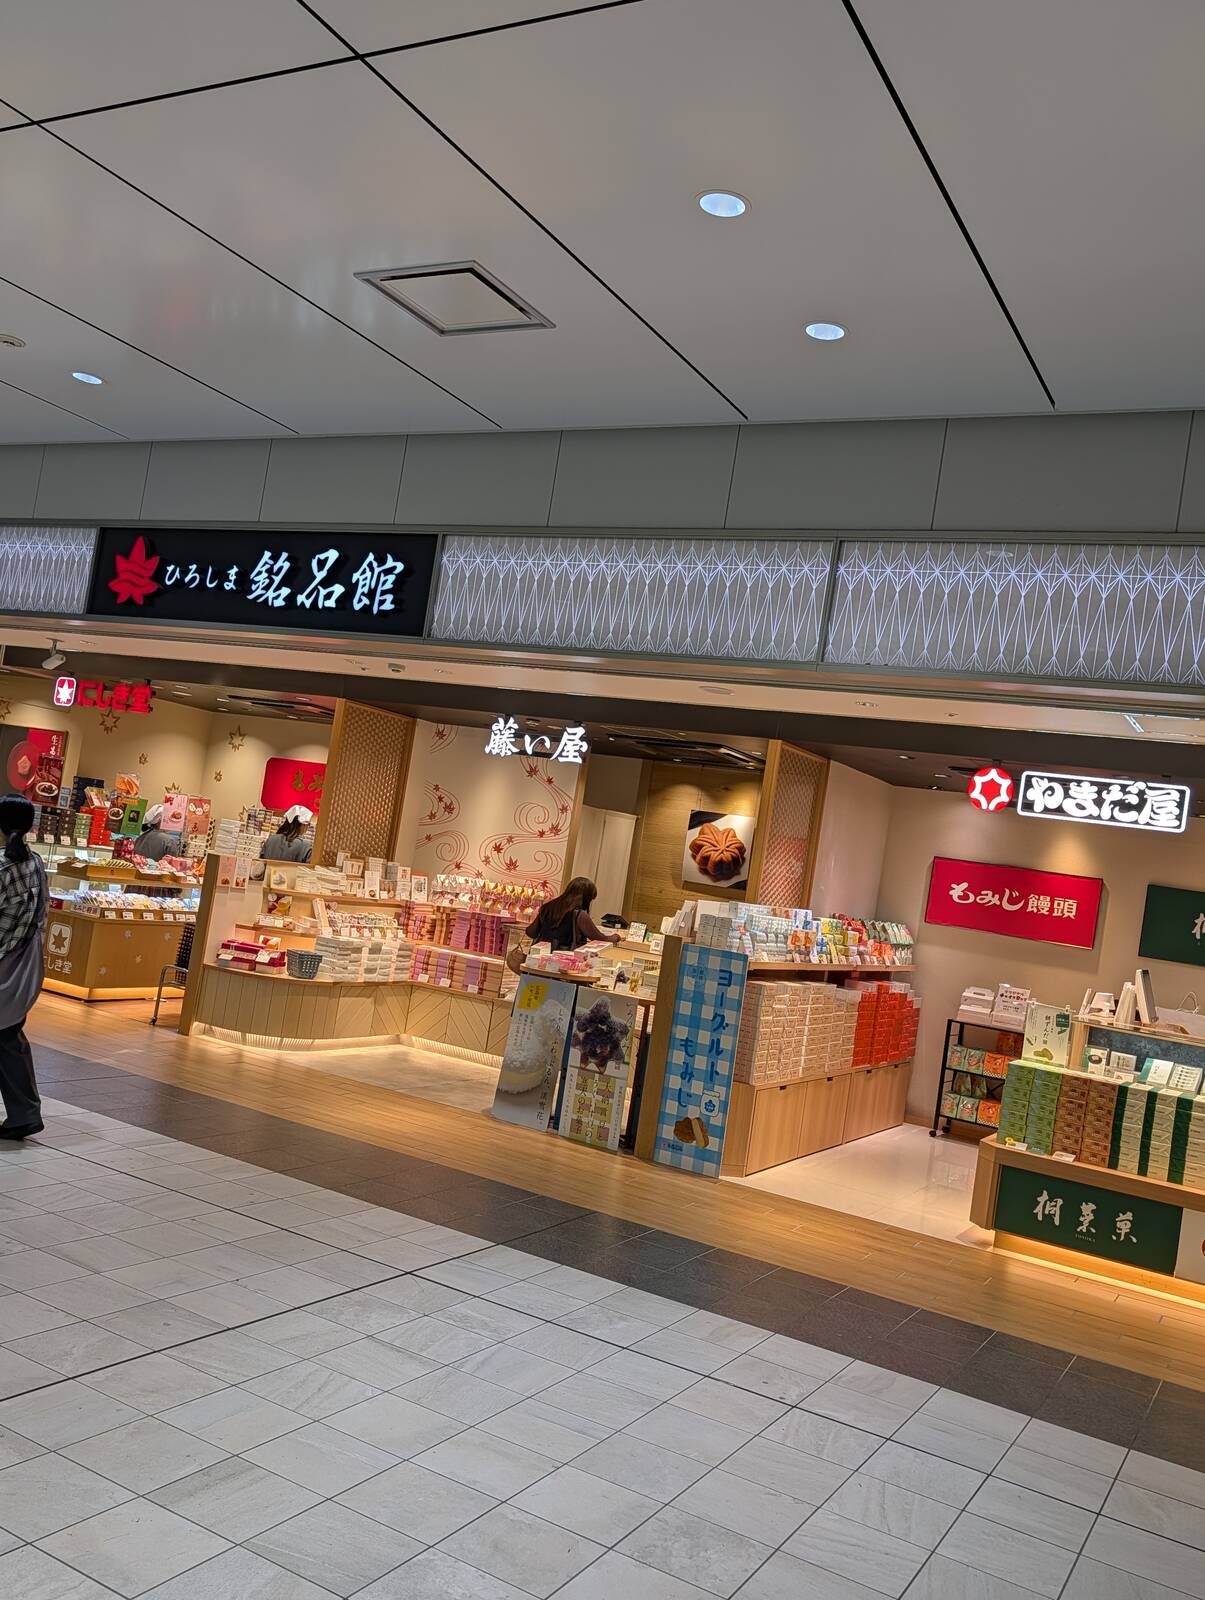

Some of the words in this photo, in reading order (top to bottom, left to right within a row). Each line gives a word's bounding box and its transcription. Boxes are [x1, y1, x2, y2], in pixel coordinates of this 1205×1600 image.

[77, 681, 150, 713] にしき堂
[485, 717, 588, 763] 藤い屋
[1026, 777, 1180, 828] やまだ屋
[949, 882, 1078, 920] もみじ饅頭
[709, 968, 733, 1083] ヨーグルト
[677, 1037, 695, 1108] もみじ
[1033, 1190, 1137, 1243] 桐葉菓
